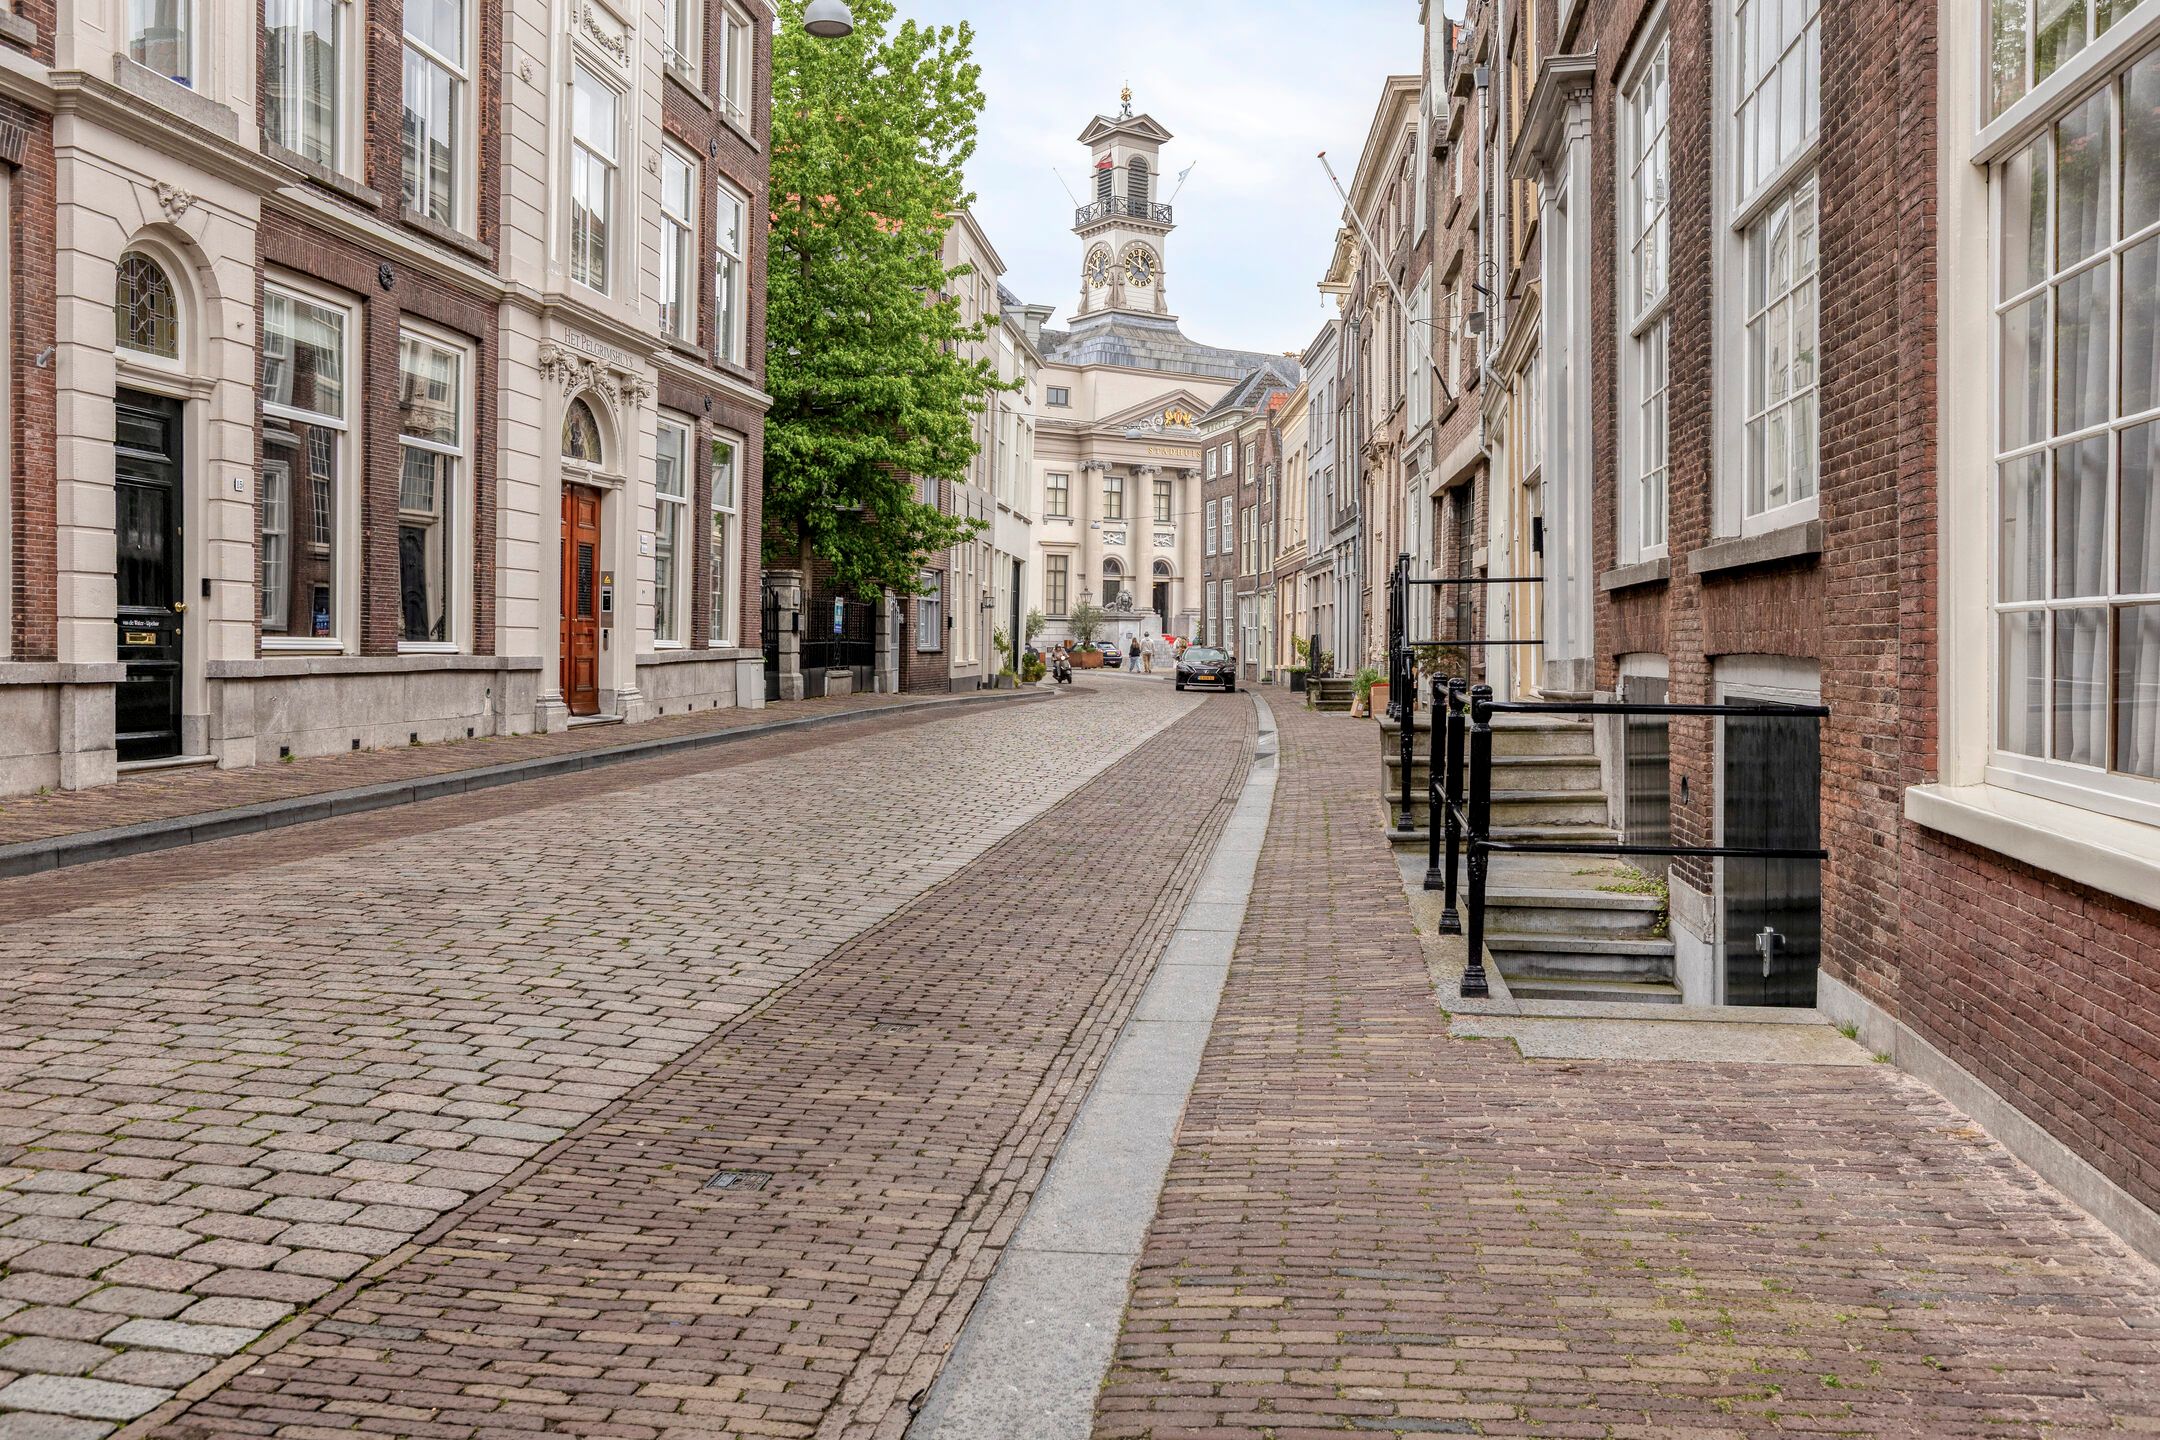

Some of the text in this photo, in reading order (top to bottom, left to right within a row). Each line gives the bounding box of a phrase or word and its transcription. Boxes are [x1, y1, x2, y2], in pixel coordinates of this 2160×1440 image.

[564, 327, 633, 368] HET PELGRIMSHUYS
[1148, 447, 1201, 458] STADHUIS
